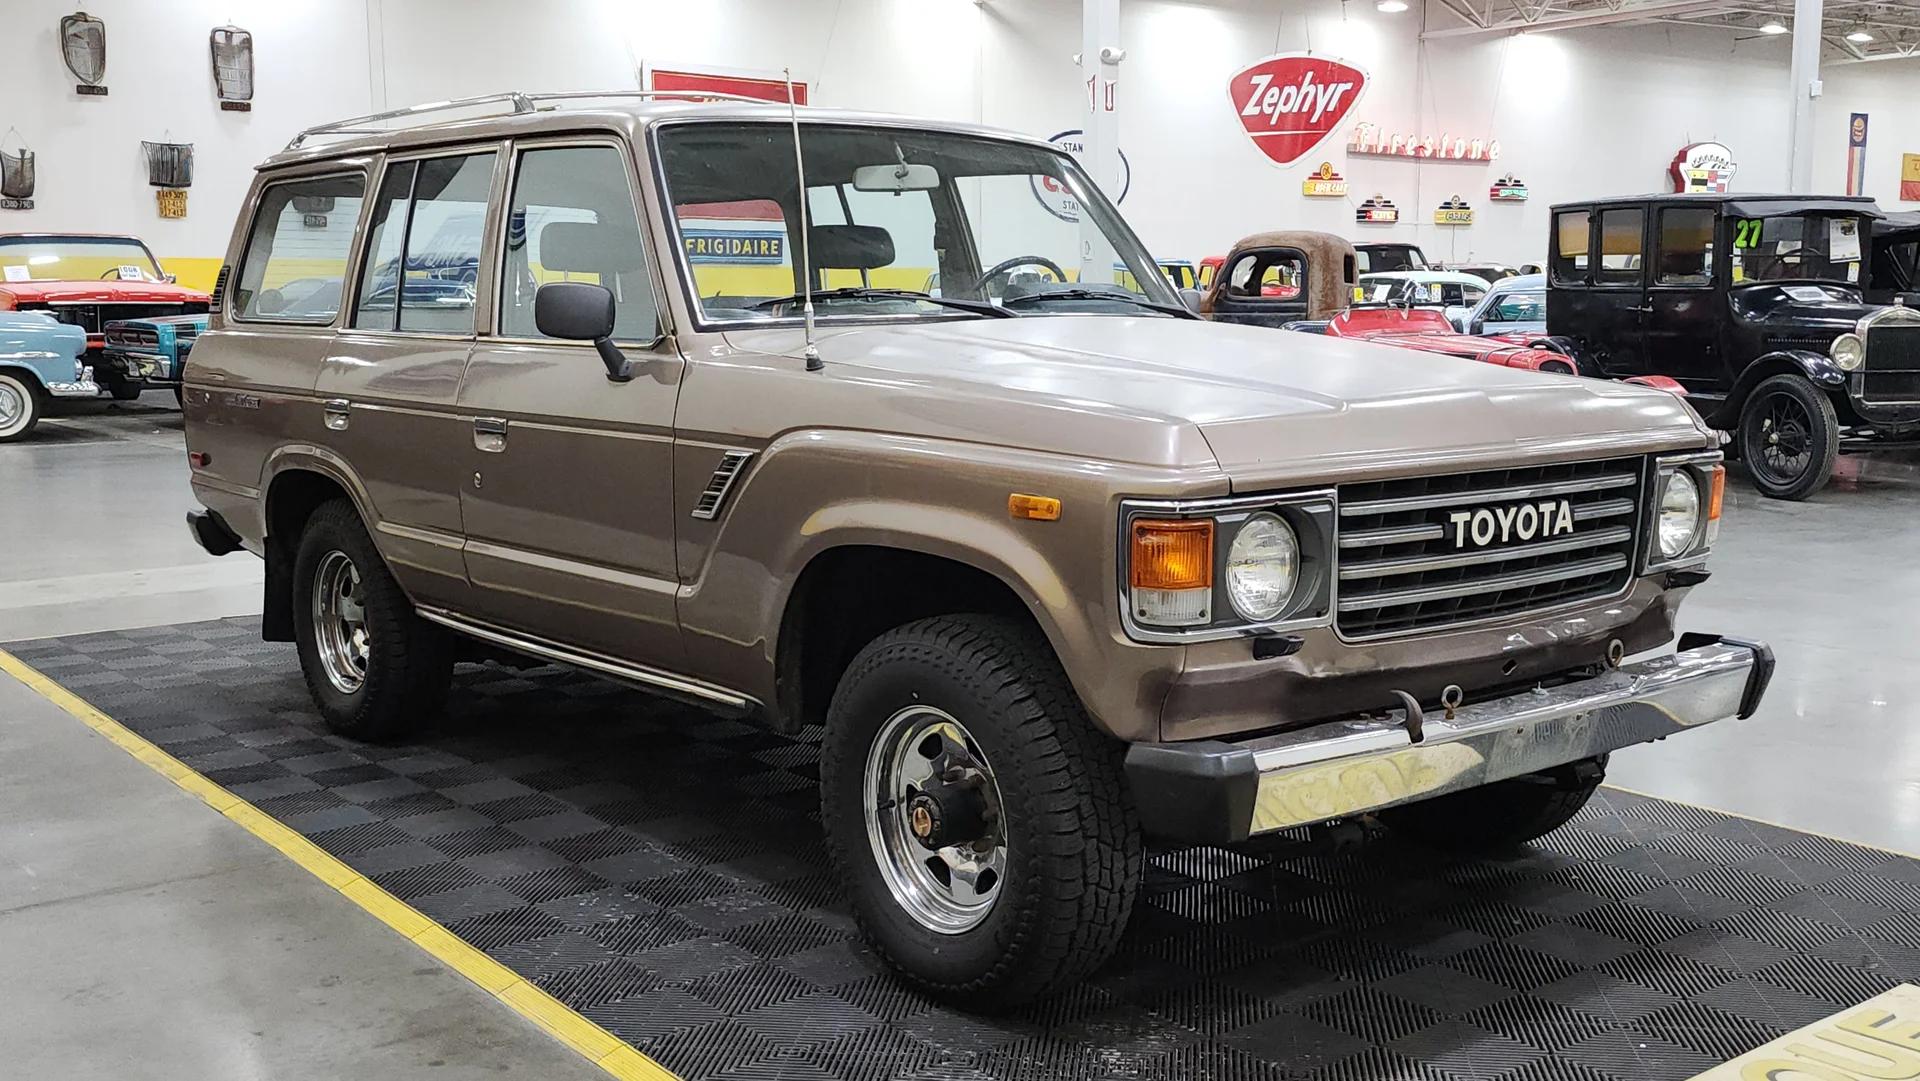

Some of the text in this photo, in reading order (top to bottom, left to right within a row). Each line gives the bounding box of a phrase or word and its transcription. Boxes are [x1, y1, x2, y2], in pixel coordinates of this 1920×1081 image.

[1241, 71, 1353, 125] Zephyr
[1355, 121, 1499, 159] Firestone
[685, 238, 779, 255] FRIGIDAIRE
[1735, 219, 1762, 248] 27
[1450, 499, 1574, 548] TOYOTA
